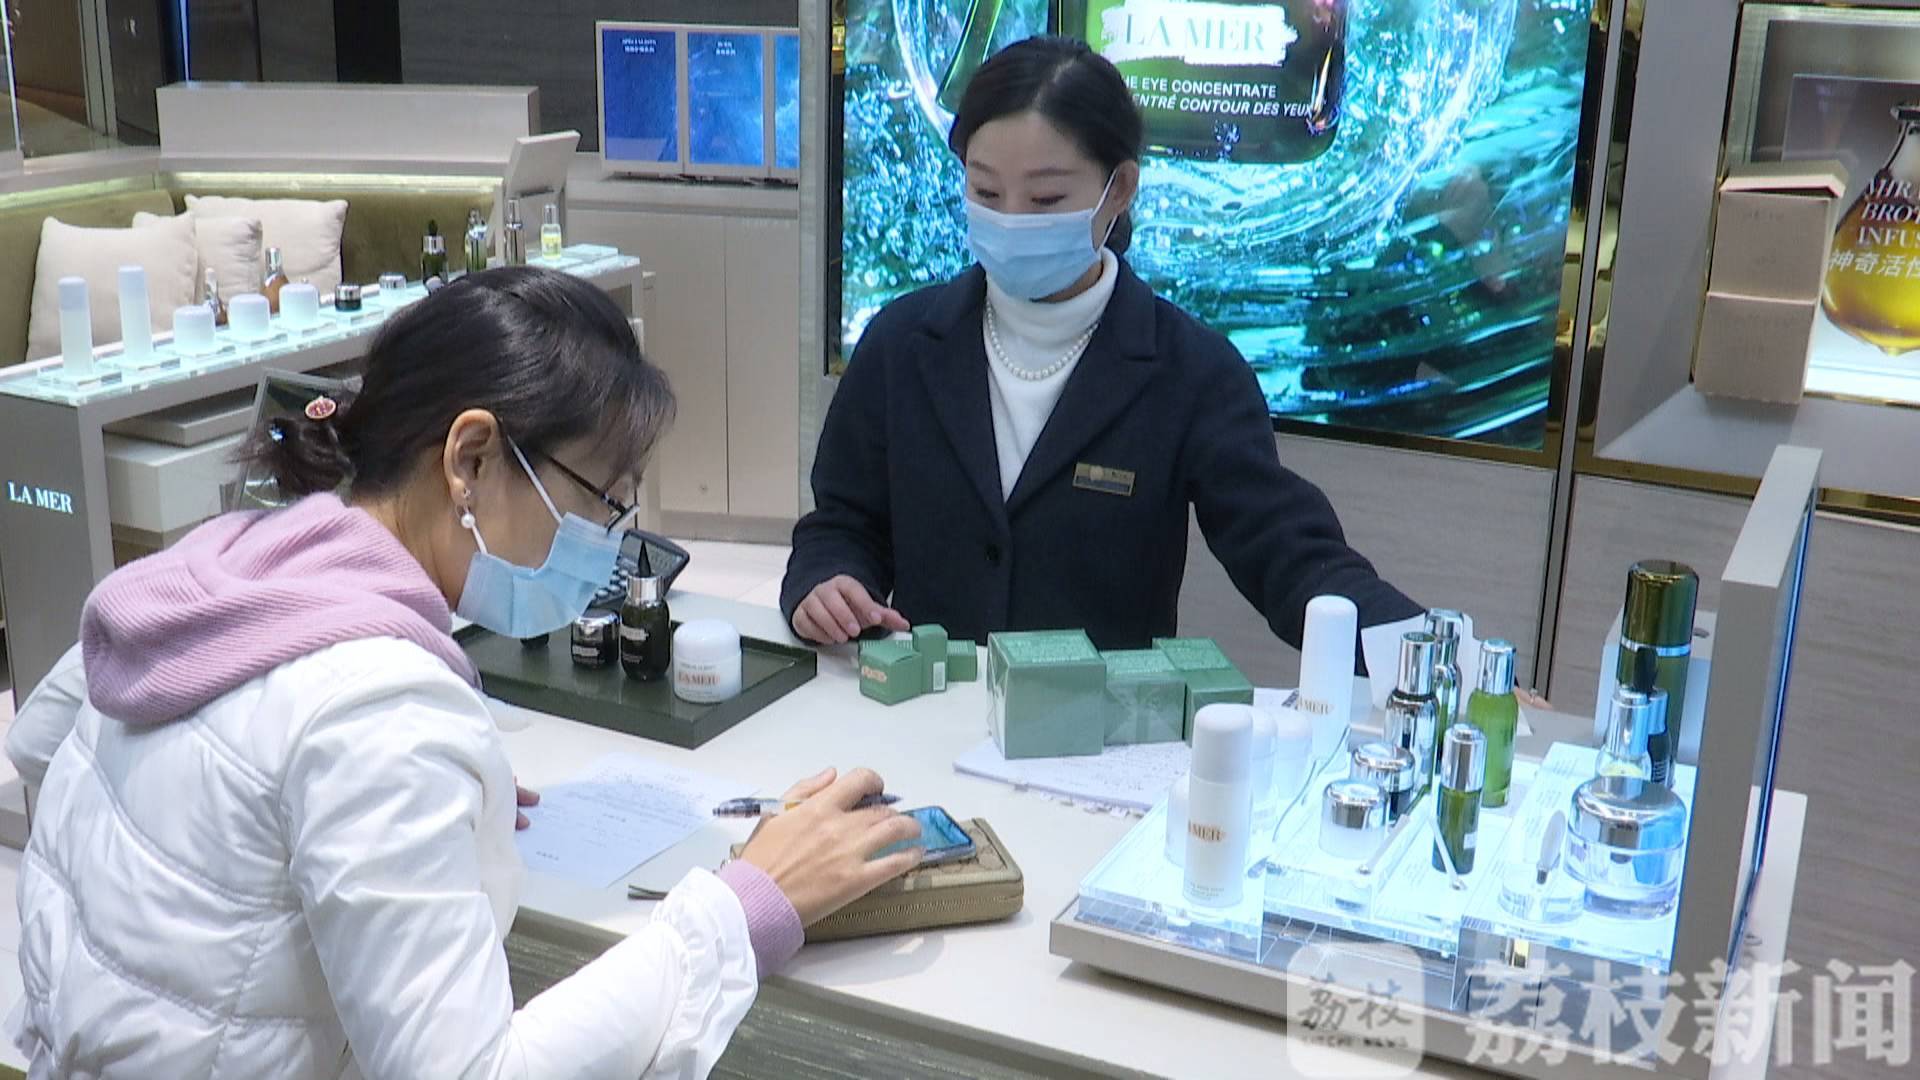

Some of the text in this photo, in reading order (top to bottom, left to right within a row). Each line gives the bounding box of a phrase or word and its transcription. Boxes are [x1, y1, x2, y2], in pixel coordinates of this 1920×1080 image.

[1125, 13, 1267, 51] LA MER
[1122, 75, 1277, 99] HE EYE CONCENTRATE
[1131, 93, 1313, 119] ENTRÉ CONTOUR DES YEUX
[8, 481, 73, 514] LA MER
